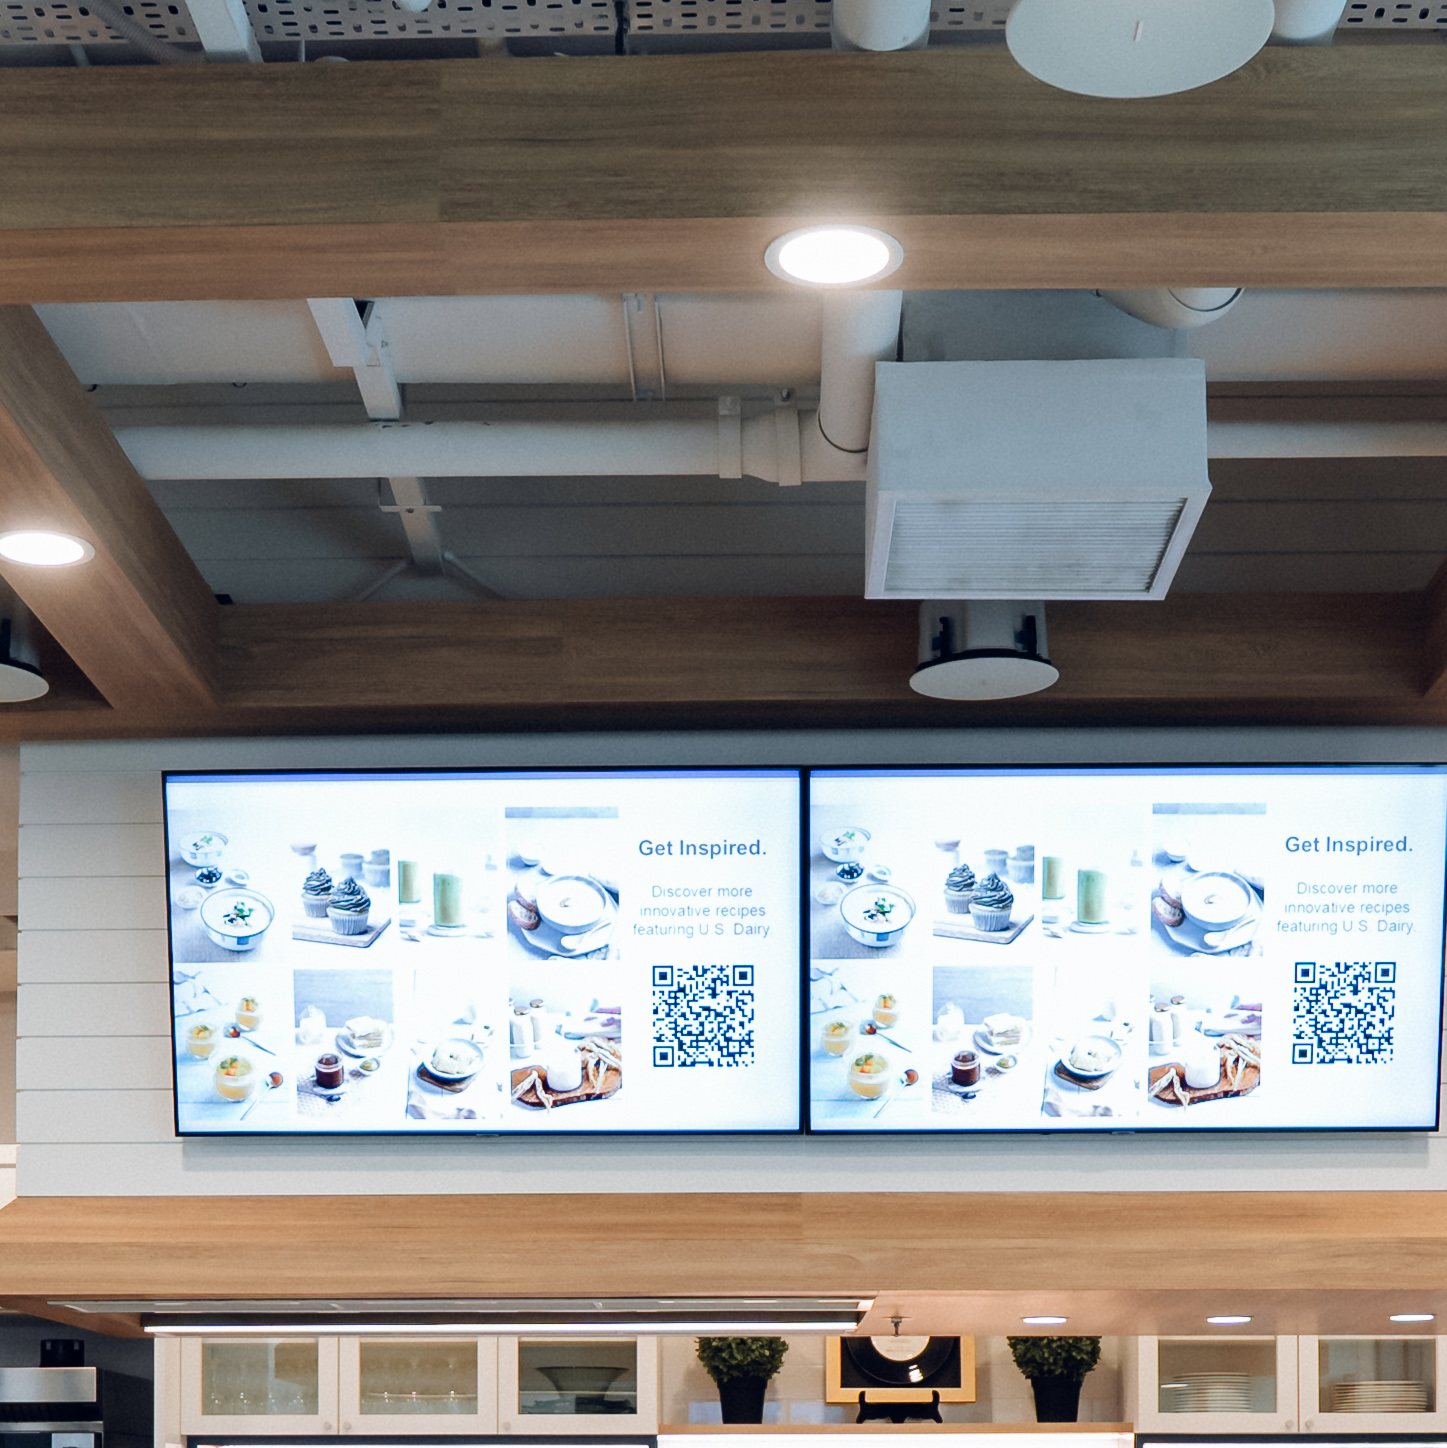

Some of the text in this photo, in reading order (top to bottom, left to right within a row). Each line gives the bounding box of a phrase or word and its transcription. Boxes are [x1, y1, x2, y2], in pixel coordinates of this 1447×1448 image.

[639, 839, 767, 859] Get Inspired.
[1285, 836, 1413, 856] Get Inspired.
[652, 885, 752, 897] Discover more
[1297, 882, 1398, 894] Discover more
[640, 905, 766, 919] innovative recipes
[1284, 902, 1410, 916] innovative recipes
[633, 923, 694, 938] featuring
[1277, 920, 1338, 935] featuring
[1377, 920, 1417, 935] Dairy.
